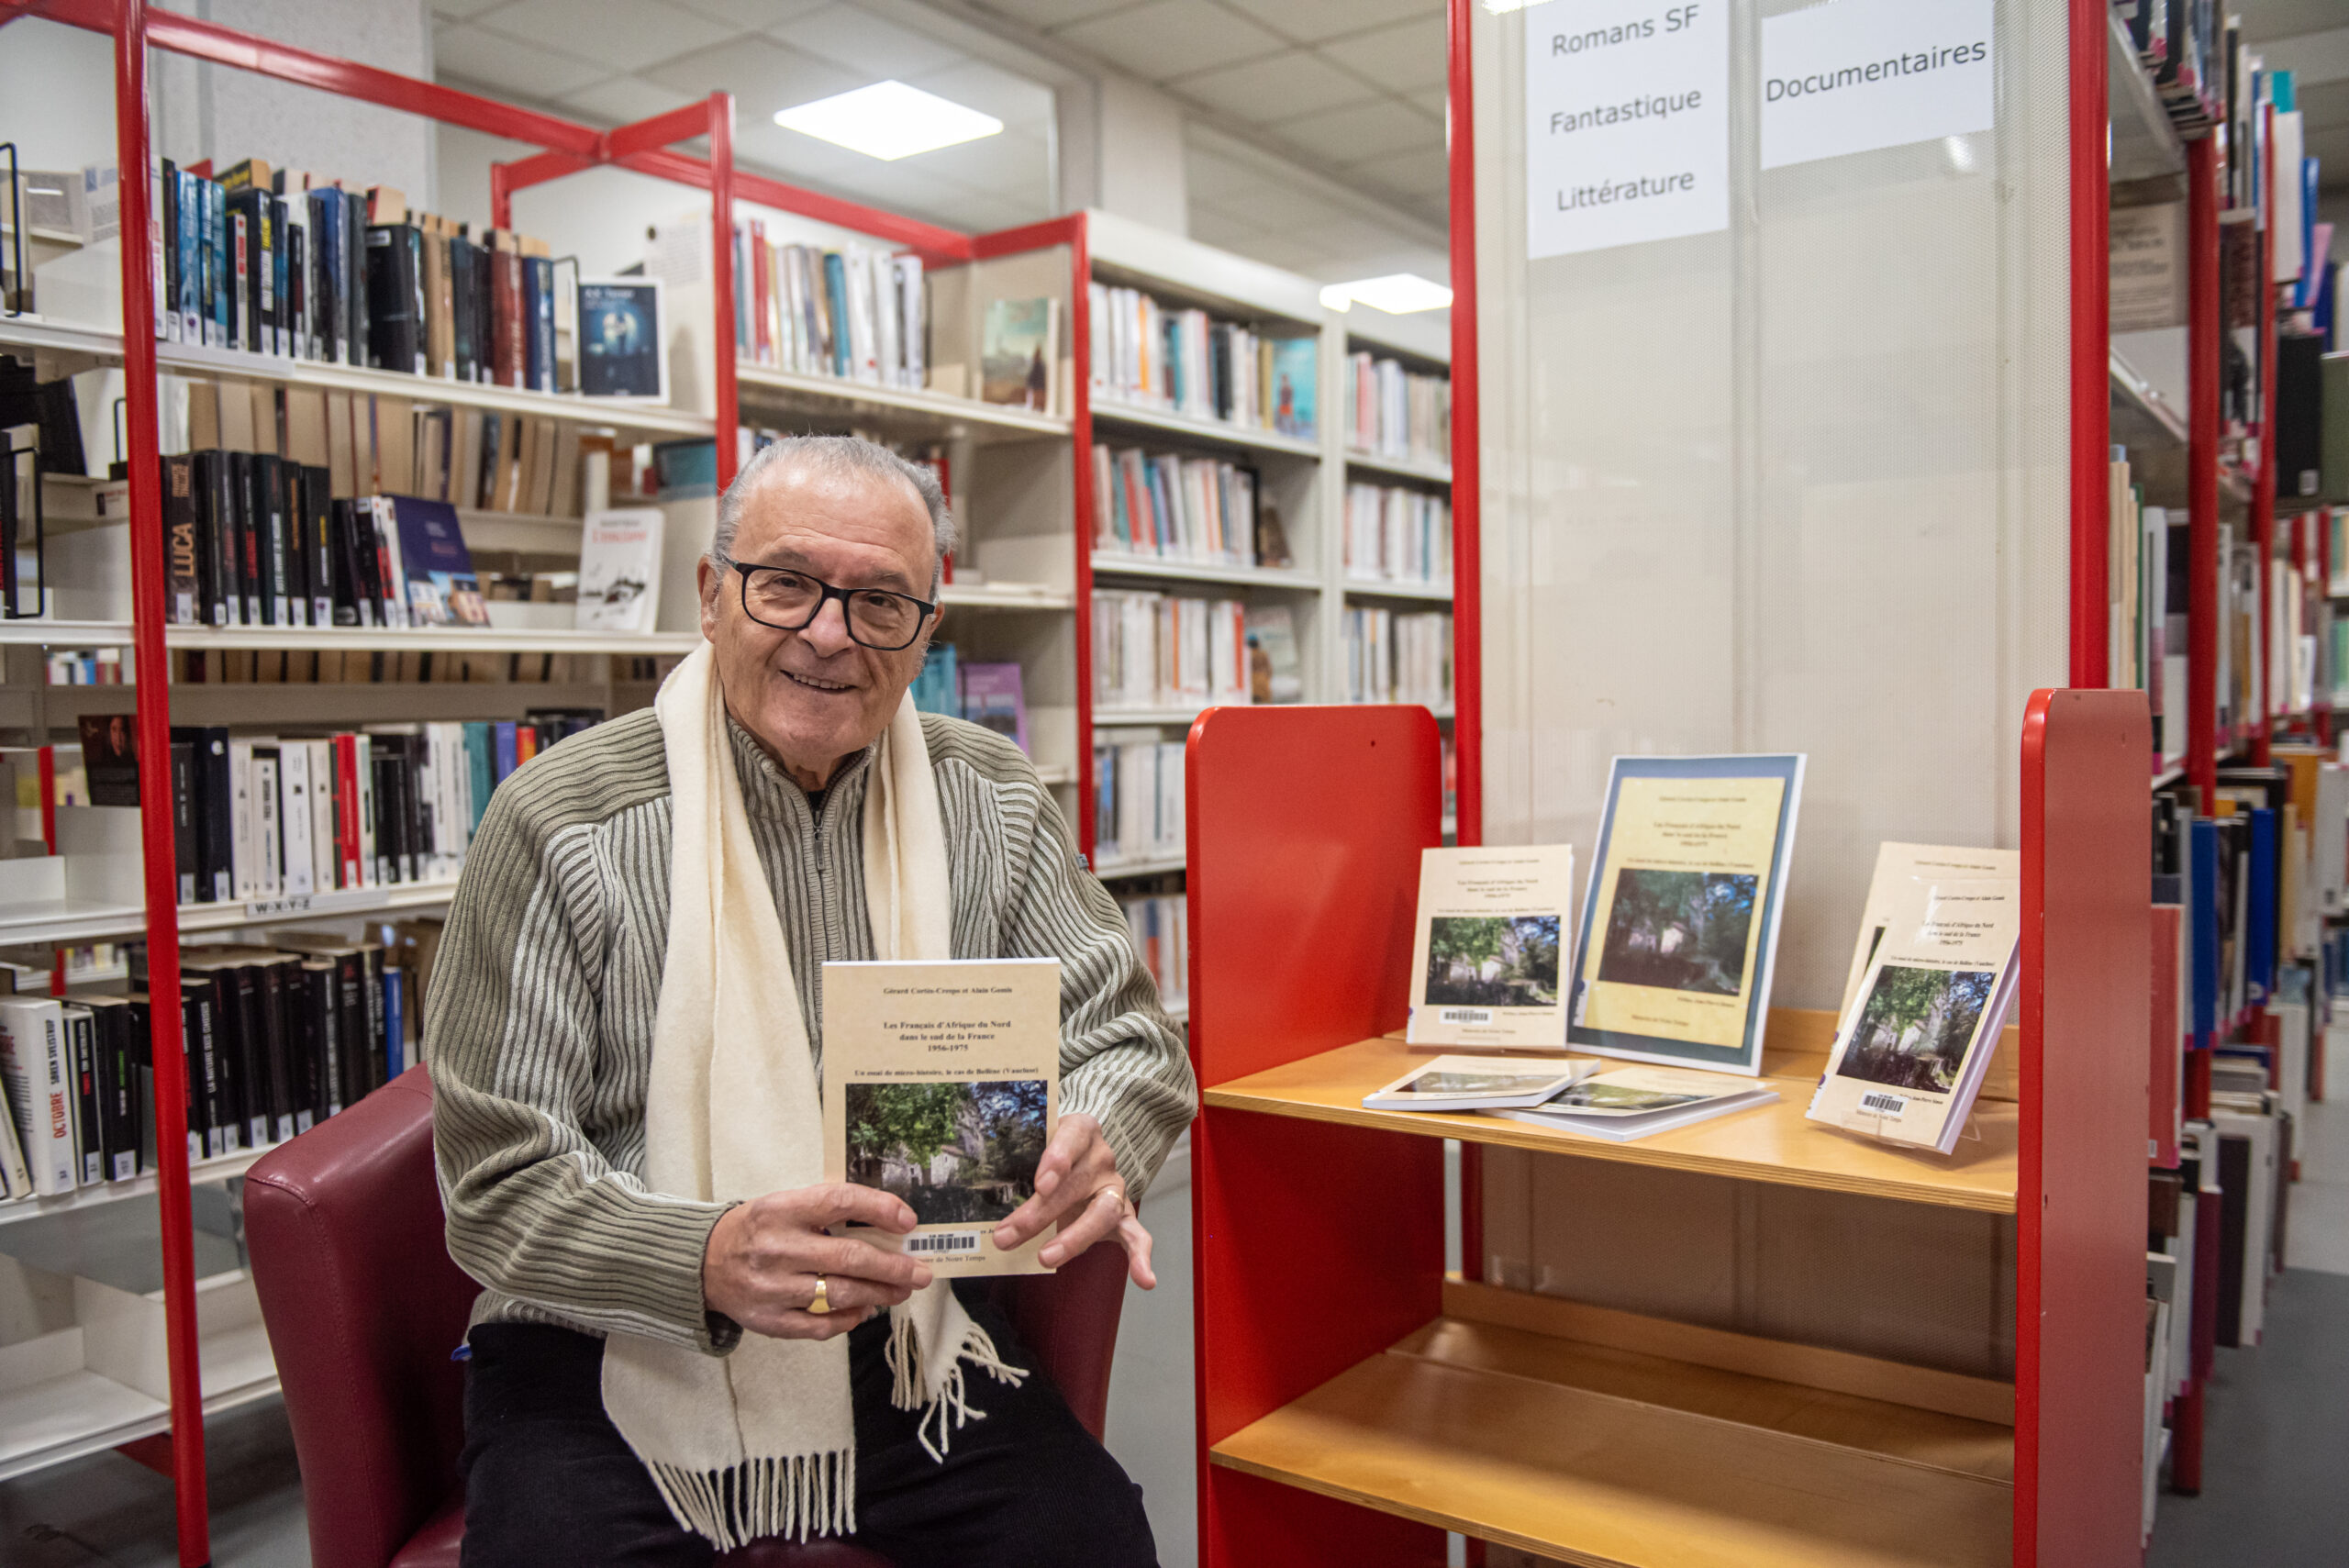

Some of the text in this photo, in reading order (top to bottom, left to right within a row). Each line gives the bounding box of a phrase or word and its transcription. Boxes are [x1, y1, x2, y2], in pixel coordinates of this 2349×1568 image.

[1552, 5, 1699, 57] Romans SF
[1765, 41, 1987, 102] Documentaires
[1551, 89, 1702, 135] Fantastique
[1556, 172, 1695, 211] Littérature
[172, 522, 195, 577] LUCA
[900, 1021, 935, 1030] Français
[937, 1020, 976, 1030] d'Afrique
[967, 1032, 996, 1040] France
[928, 1043, 969, 1052] 1956-1975
[50, 1090, 68, 1140] OCTOBRE
[965, 1254, 986, 1262] Temps
